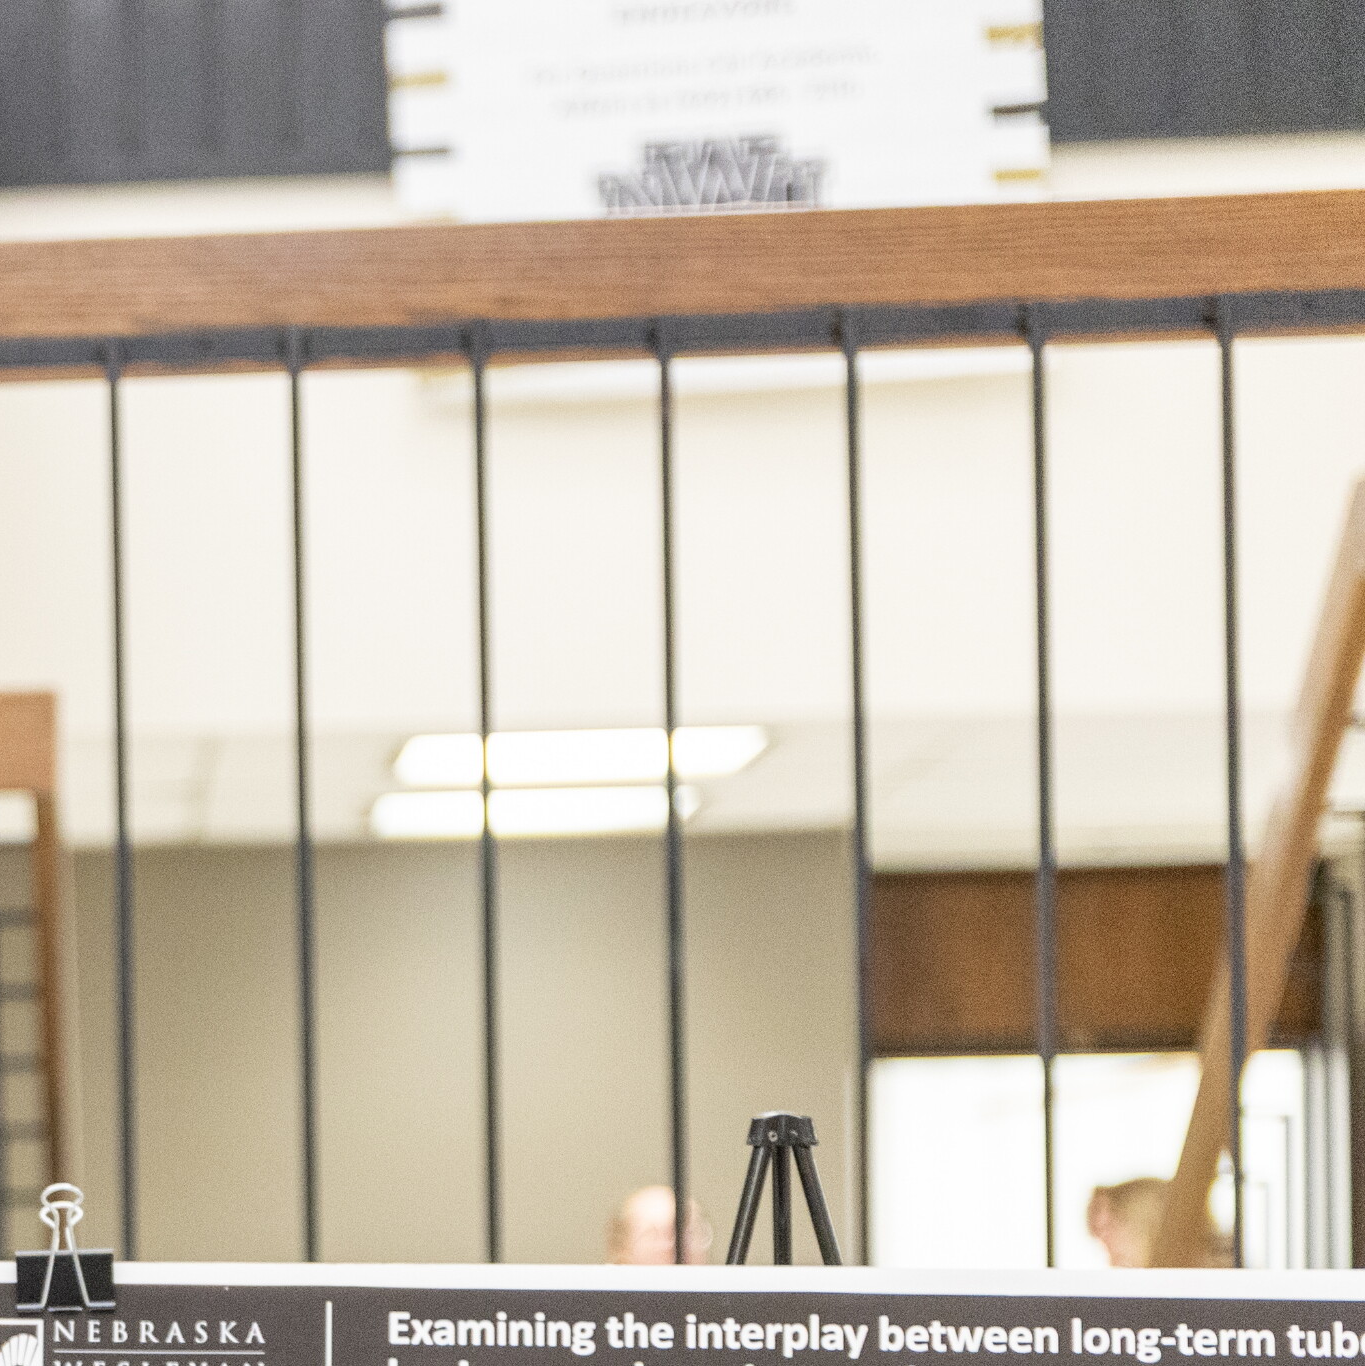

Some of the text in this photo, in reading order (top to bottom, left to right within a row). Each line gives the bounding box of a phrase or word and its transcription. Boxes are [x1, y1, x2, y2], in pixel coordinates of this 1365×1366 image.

[54, 1321, 263, 1343] NEBRASKA
[390, 1311, 1365, 1363] Examining the interplay between long-term tub
